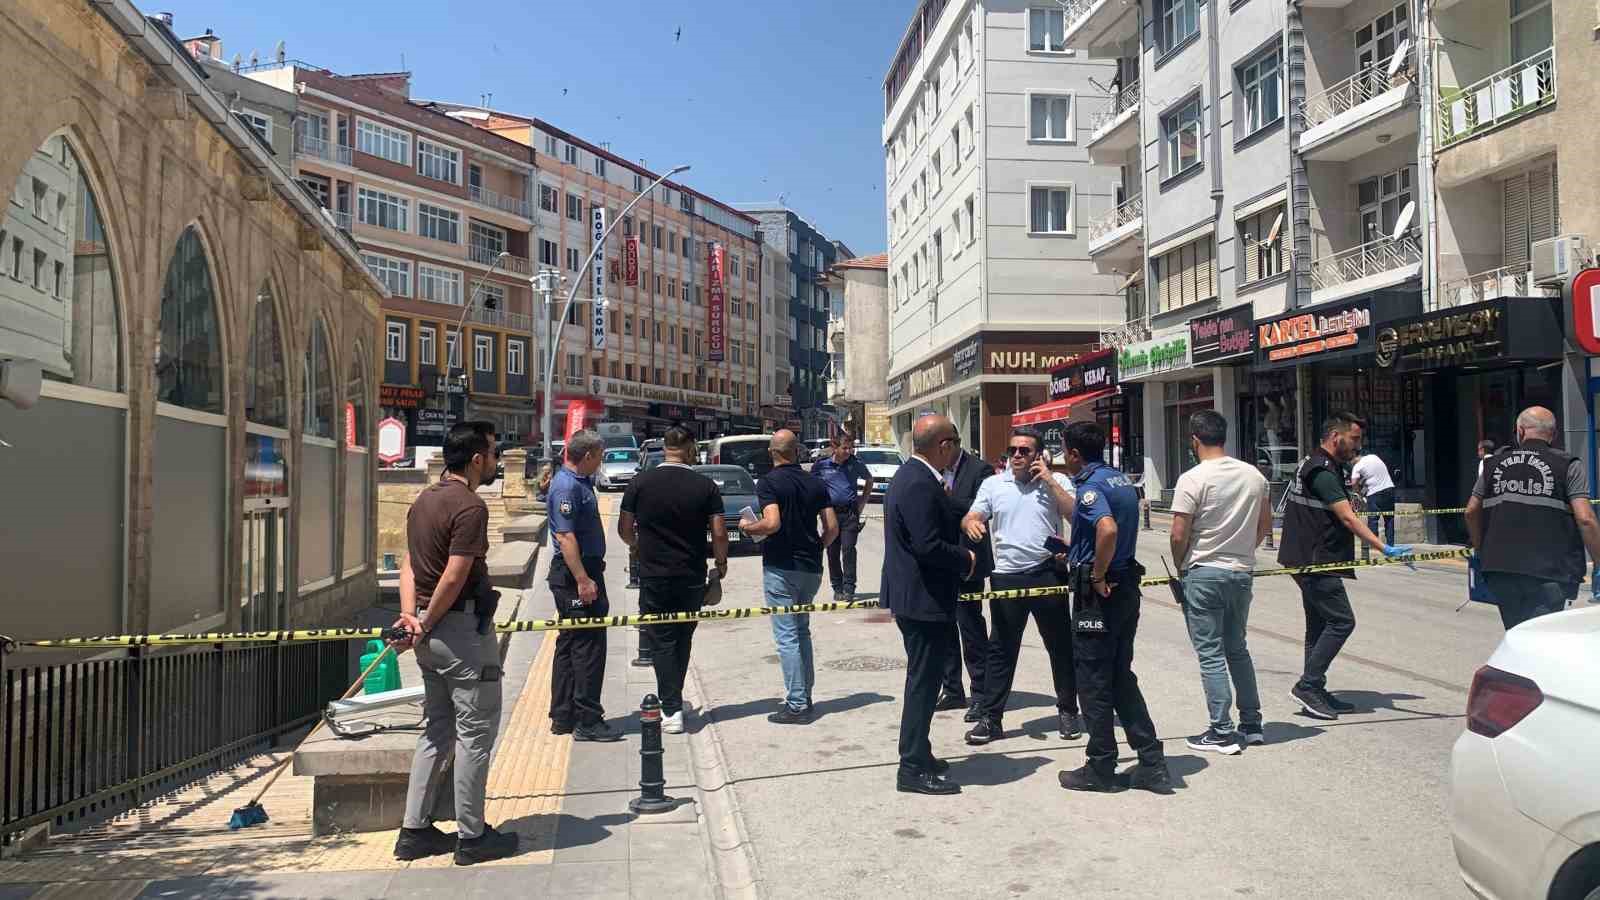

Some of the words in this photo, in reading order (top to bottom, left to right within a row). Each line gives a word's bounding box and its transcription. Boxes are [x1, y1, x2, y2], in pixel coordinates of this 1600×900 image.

[594, 211, 603, 261] DOĞN
[596, 266, 604, 337] TELKOM
[1259, 314, 1320, 348] KARTEL
[990, 351, 1036, 369] NUH
[1084, 366, 1106, 387] KEBAP
[1500, 478, 1542, 495] POLİS
[1078, 619, 1104, 630] POLİS
